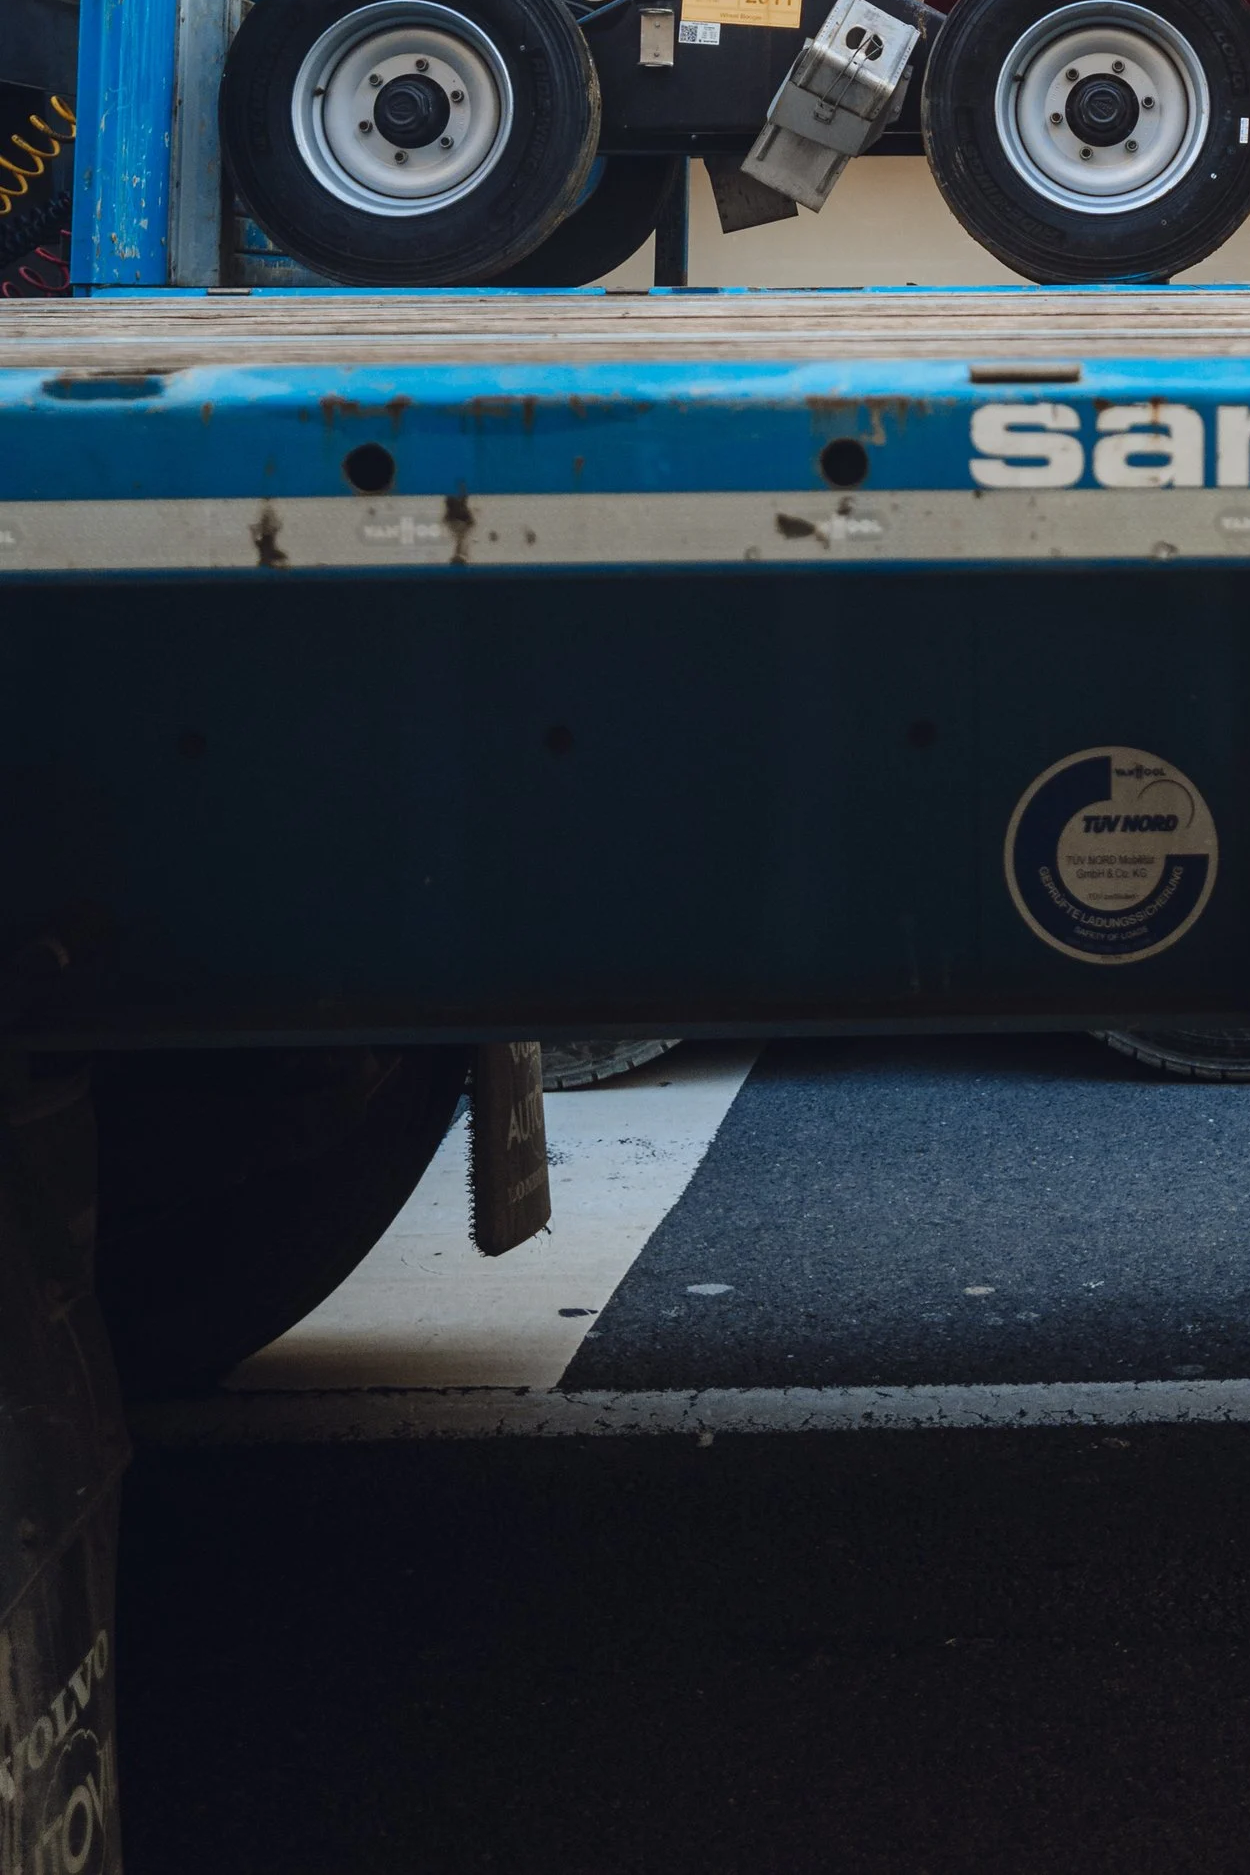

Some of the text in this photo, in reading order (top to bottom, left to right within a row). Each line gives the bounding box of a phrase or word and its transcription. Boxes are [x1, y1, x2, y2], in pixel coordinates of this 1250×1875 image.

[1120, 815, 1179, 833] NORD
[1088, 854, 1116, 865] NORD
[1076, 867, 1105, 879] GmbH
[1106, 867, 1114, 879] &
[1132, 867, 1148, 879] KG
[1080, 865, 1184, 929] LADUNGSSICHERUNG
